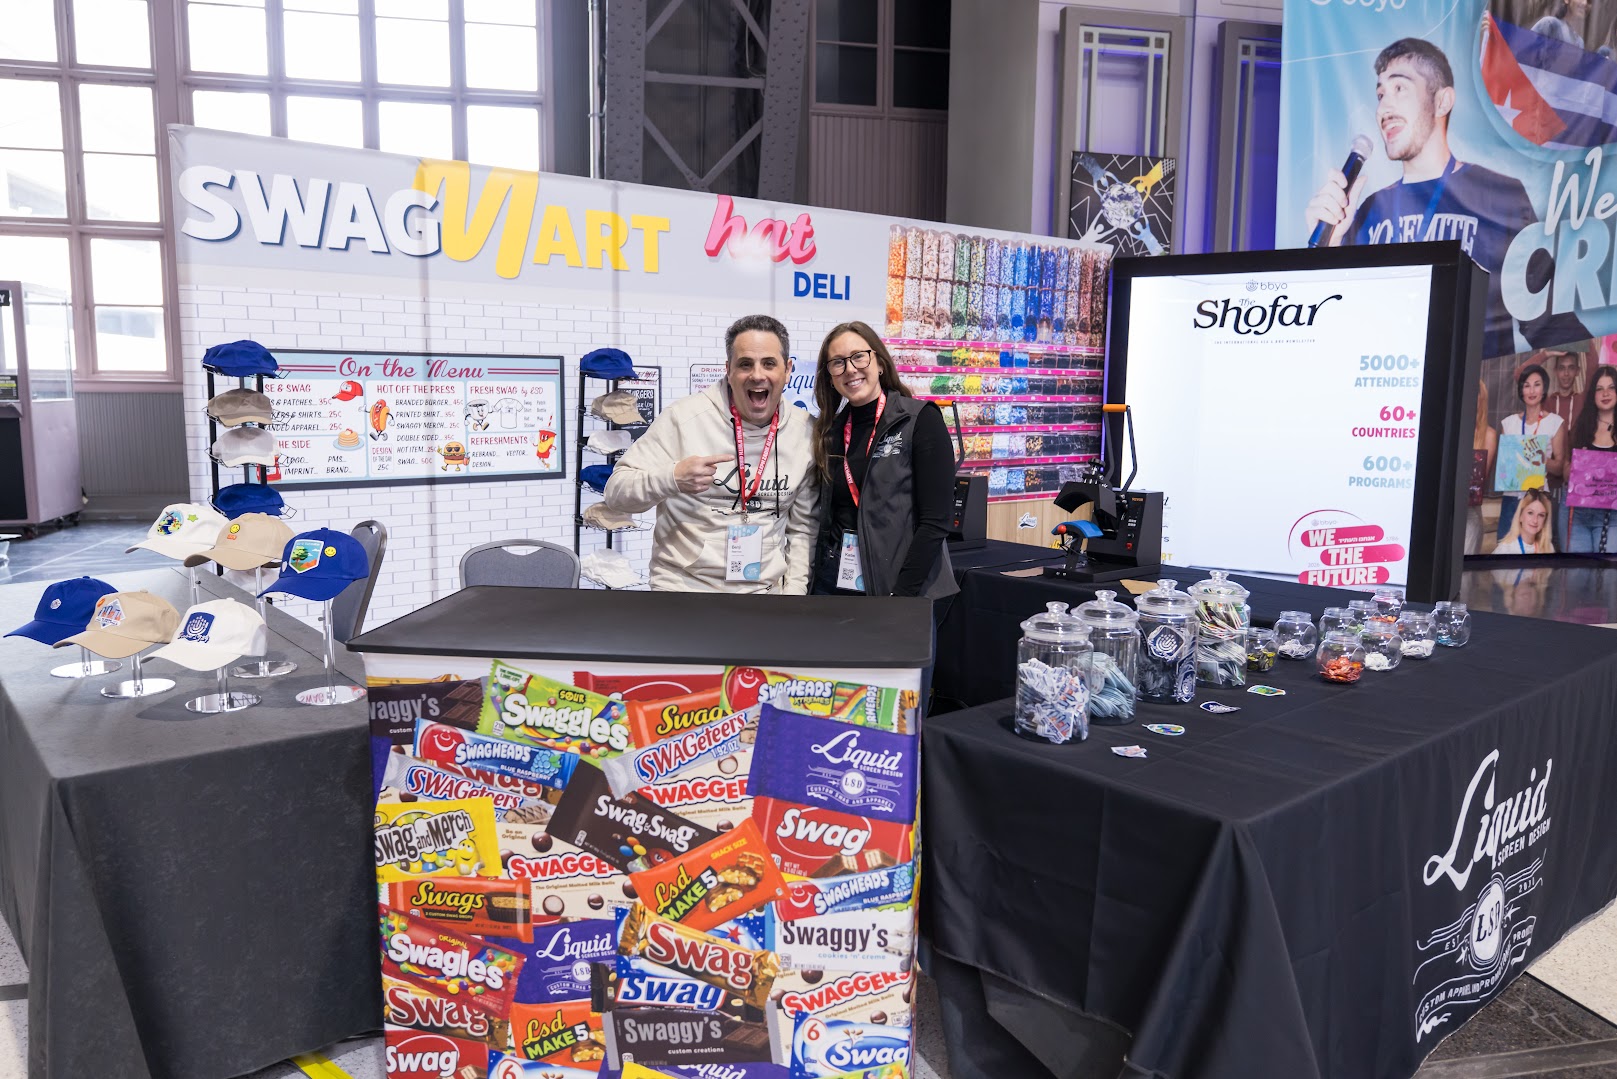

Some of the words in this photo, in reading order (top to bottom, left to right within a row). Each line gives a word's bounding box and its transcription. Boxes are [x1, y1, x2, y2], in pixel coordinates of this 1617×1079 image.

[1544, 146, 1617, 236] We
[704, 194, 817, 265] hat
[1501, 216, 1617, 322] CR
[794, 271, 850, 300] DELI
[1193, 294, 1343, 335] Shofar
[339, 357, 373, 377] On
[374, 358, 418, 378] the
[426, 359, 485, 378] Menu
[1359, 354, 1420, 371] 5000+
[286, 383, 312, 393] SWAG
[376, 385, 393, 394] HOT
[396, 385, 411, 394] OFF
[413, 385, 429, 394] THE
[430, 385, 455, 394] PRESS
[470, 386, 494, 395] FRESH
[495, 386, 518, 395] SWAG
[1354, 376, 1419, 388] ATTENDEES
[1379, 405, 1416, 421] 60+
[291, 440, 311, 448] SIDE
[470, 436, 528, 446] REFRESHMENTS
[1351, 427, 1416, 438] COUNTRIES
[371, 447, 393, 455] DESIGN
[1363, 455, 1413, 472] 600+
[1348, 476, 1413, 489] PROGRAMS
[1308, 528, 1337, 547] WE
[1327, 546, 1365, 566] THE
[1307, 566, 1379, 587] FUTURE
[559, 689, 586, 704] SOUR
[758, 680, 833, 702] SWAGHEADS
[502, 693, 629, 750] Swaggles
[455, 742, 532, 763] SWAGHEADS
[640, 713, 746, 782] SWAGeteers
[811, 730, 903, 771] Liquid
[500, 764, 516, 773] BLUE
[516, 767, 551, 781] RASPBERRY
[844, 777, 863, 789] LSD
[416, 830, 432, 850] and
[427, 812, 472, 849] Merch
[594, 794, 648, 835] Swag
[648, 815, 697, 852] Swag
[776, 808, 869, 856] Swag
[1423, 749, 1552, 891] Liquid
[710, 844, 733, 860] SNACK
[732, 838, 748, 849] SIZE
[1498, 832, 1525, 868] SCREEN
[1528, 817, 1552, 848] DESIGN
[411, 880, 485, 914] Swags
[656, 863, 692, 913] Lsd
[662, 881, 707, 921] MAKE
[701, 869, 718, 889] 5
[813, 870, 890, 914] SWAGHEADS
[863, 896, 880, 904] BLUE
[536, 928, 613, 961] Liquid
[783, 920, 889, 953] Swaggy's
[388, 933, 504, 989] Swagles
[648, 922, 753, 987] Swag
[622, 976, 723, 1010] Swag
[388, 987, 489, 1035] Swag
[522, 1010, 566, 1045] Lsd
[526, 1030, 577, 1060] MAKE
[574, 1023, 589, 1041] 5
[623, 1016, 723, 1044] Swaggy's
[807, 1023, 820, 1041] 6
[385, 1045, 457, 1077] Swag
[693, 1046, 725, 1054] creations
